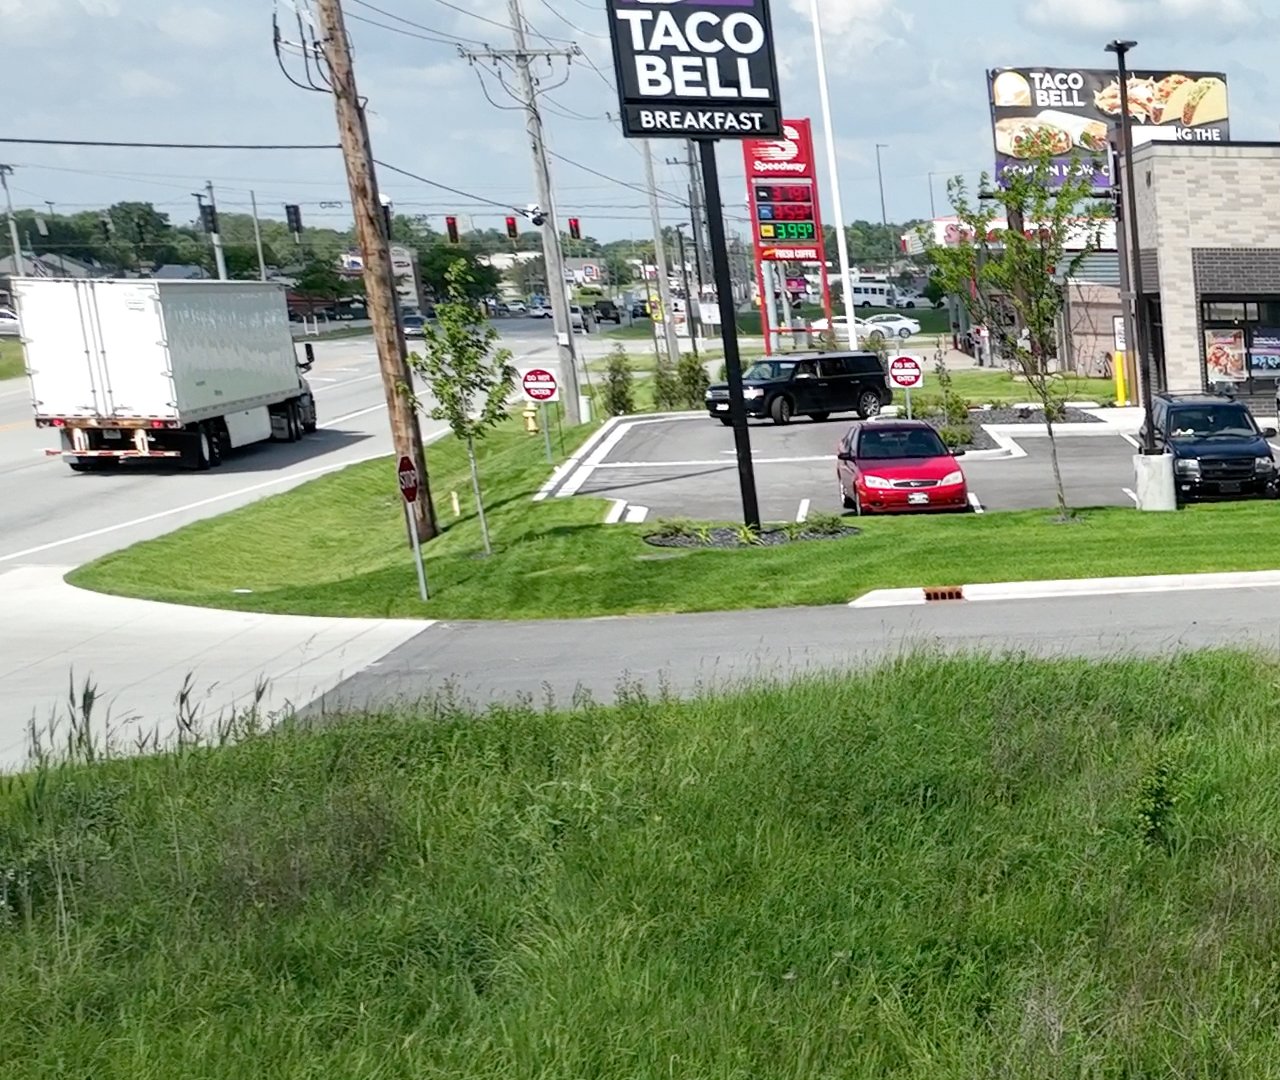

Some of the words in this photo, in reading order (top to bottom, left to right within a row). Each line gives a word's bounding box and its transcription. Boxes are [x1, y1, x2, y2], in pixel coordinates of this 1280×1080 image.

[616, 9, 765, 54] TACO
[634, 54, 770, 98] BELL
[1030, 72, 1084, 90] TACO
[1035, 90, 1087, 107] BELL
[640, 110, 764, 131] BREAKFAST
[1194, 128, 1221, 141] THE
[753, 160, 807, 173] Speedway
[400, 470, 417, 490] STOP
